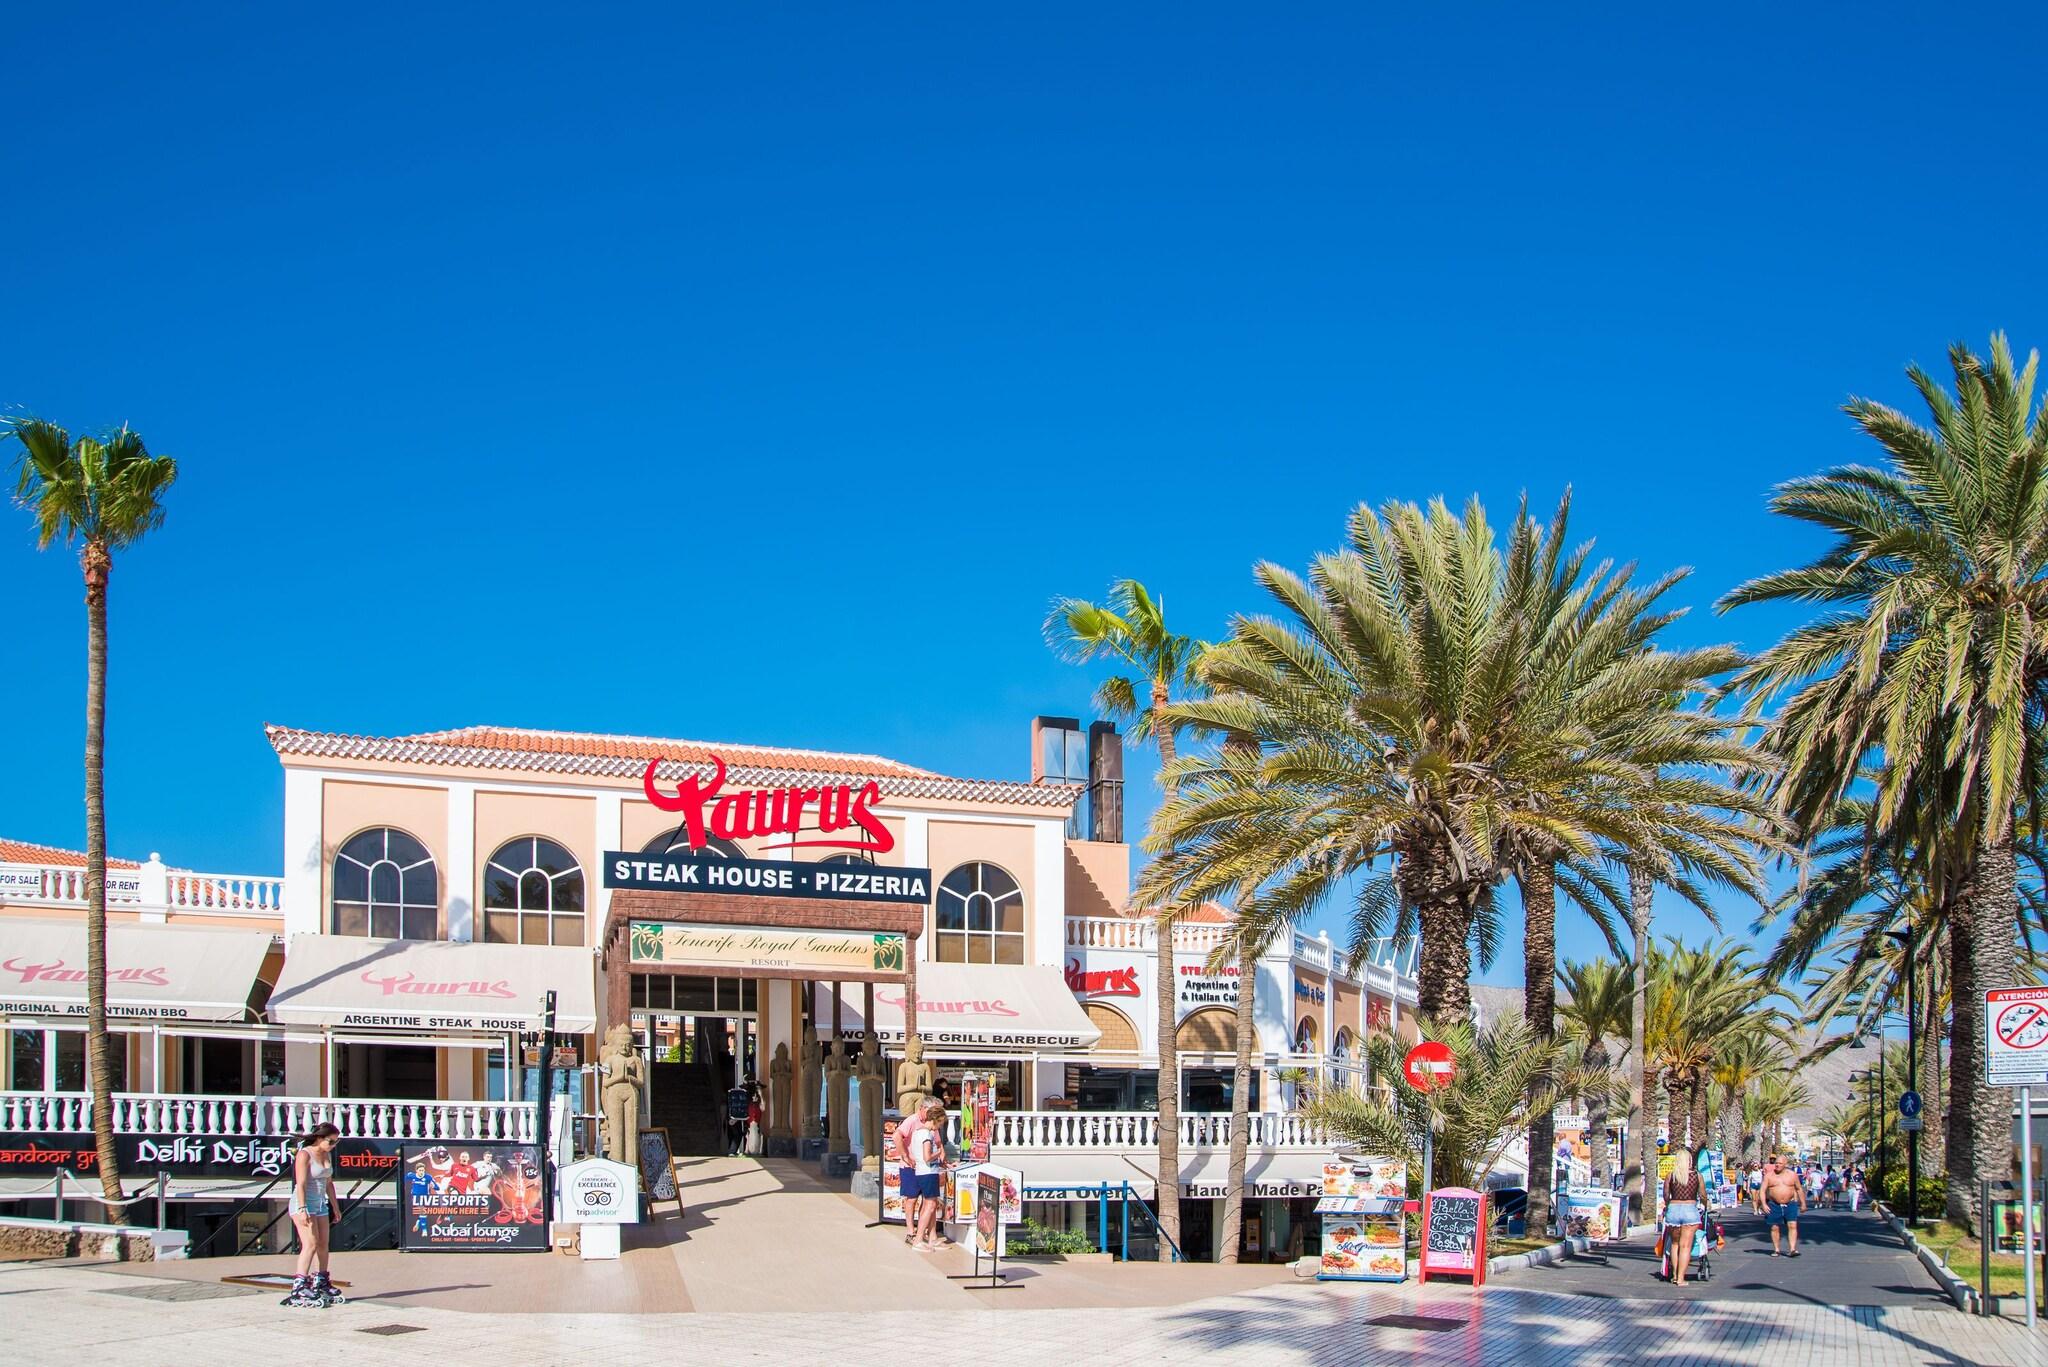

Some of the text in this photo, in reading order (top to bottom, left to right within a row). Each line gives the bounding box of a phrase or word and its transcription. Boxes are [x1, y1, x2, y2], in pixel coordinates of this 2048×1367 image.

[644, 753, 895, 854] Taurus
[0, 875, 39, 885] FOR SALE
[614, 860, 926, 897] STEAK HOUSE PIZZERIA
[106, 880, 140, 890] OR RENT
[668, 930, 869, 955] Tenerife Royal Gardens
[751, 958, 791, 967] RESORT
[361, 970, 517, 999] Taurus
[1185, 980, 1229, 992] Argentine
[1181, 992, 1188, 1002] &
[1191, 993, 1220, 1002] Italian
[67, 1005, 157, 1016] ARNTINIAN
[160, 1008, 188, 1017] BBQ
[343, 1015, 527, 1031] ARGENTINE STEAK HOUSE
[896, 1032, 933, 1041] FRE
[938, 1033, 989, 1044] GRILL
[992, 1035, 1080, 1045] BARBECUE
[136, 1137, 206, 1163] Delhi
[1026, 1187, 1067, 1199] izza
[1252, 1184, 1299, 1196] Made
[1306, 1184, 1323, 1196] Pa
[412, 1195, 489, 1207] LIVE SPORTS
[1436, 1199, 1470, 1215] Paella
[422, 1207, 479, 1215] SHOWING HERE
[577, 1208, 617, 1216] tripadvisor
[1431, 1215, 1460, 1233] Fresh
[430, 1222, 520, 1242] Dubai lounge
[1430, 1233, 1461, 1250] Pasta
